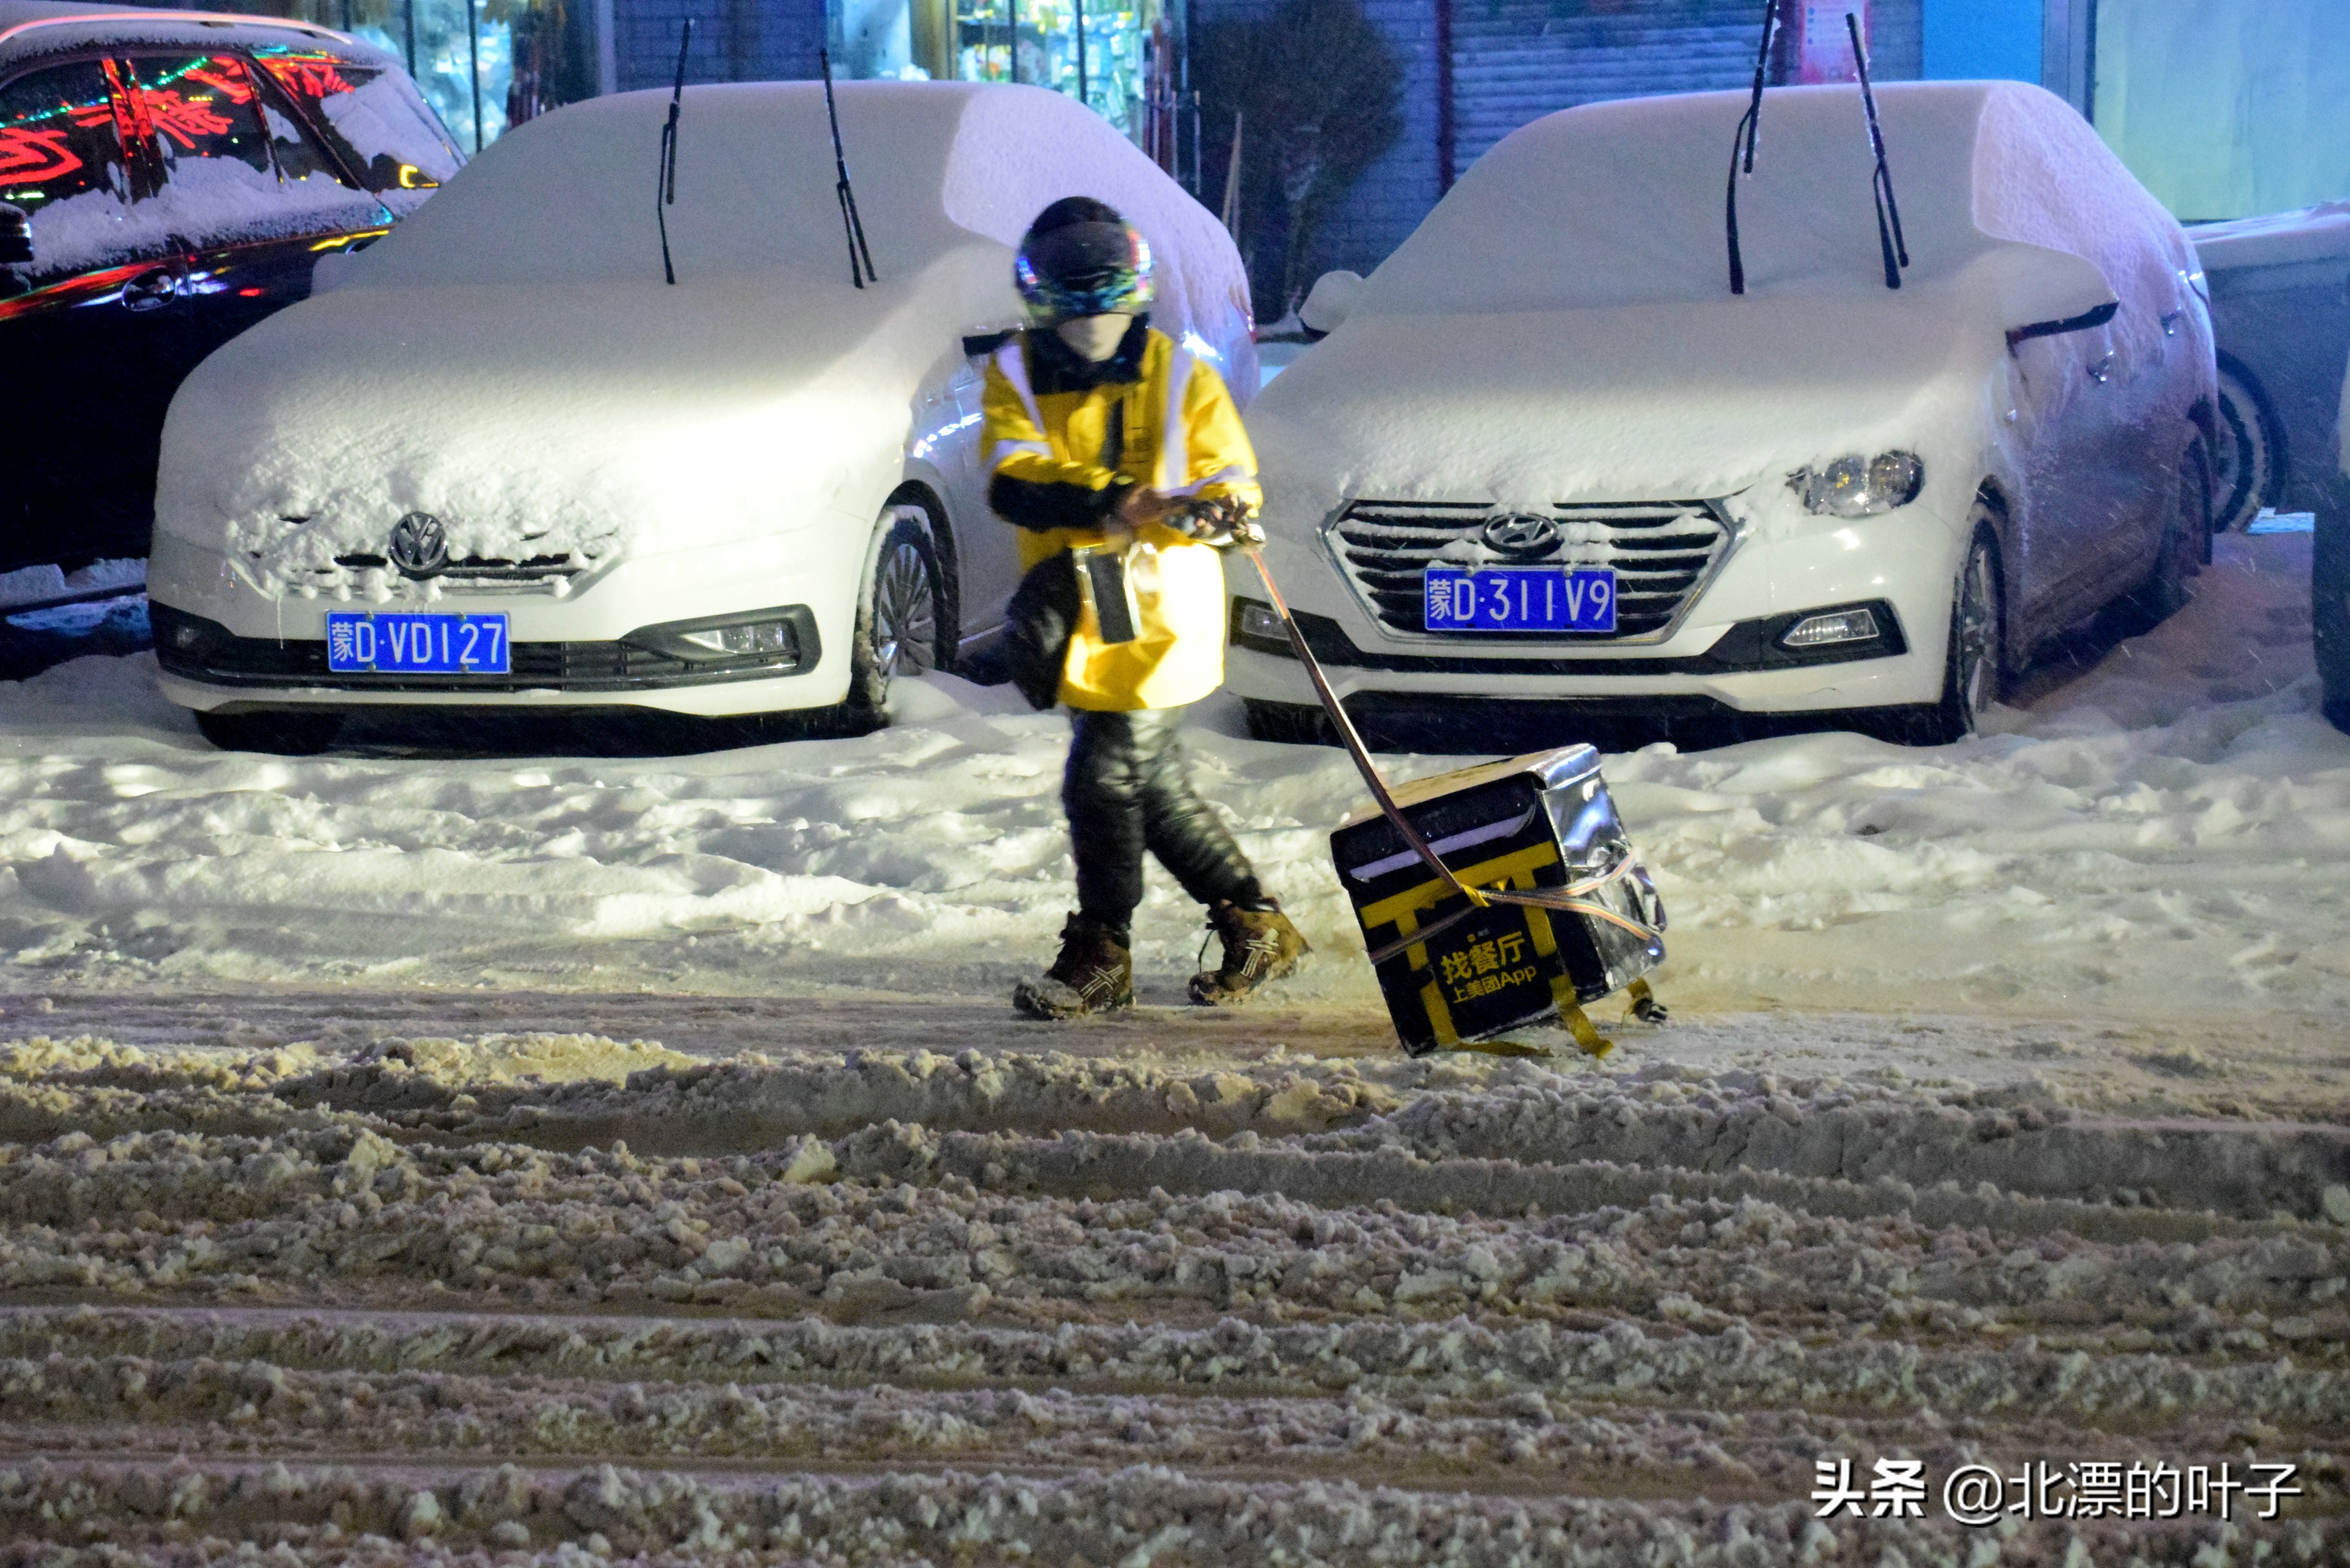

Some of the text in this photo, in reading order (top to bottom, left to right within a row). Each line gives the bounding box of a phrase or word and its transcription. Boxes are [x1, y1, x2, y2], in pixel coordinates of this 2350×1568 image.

[1429, 579, 1610, 621] 蒙D·311V9
[331, 621, 502, 664] 蒙D·VD127
[1441, 931, 1525, 985] 找餐厅
